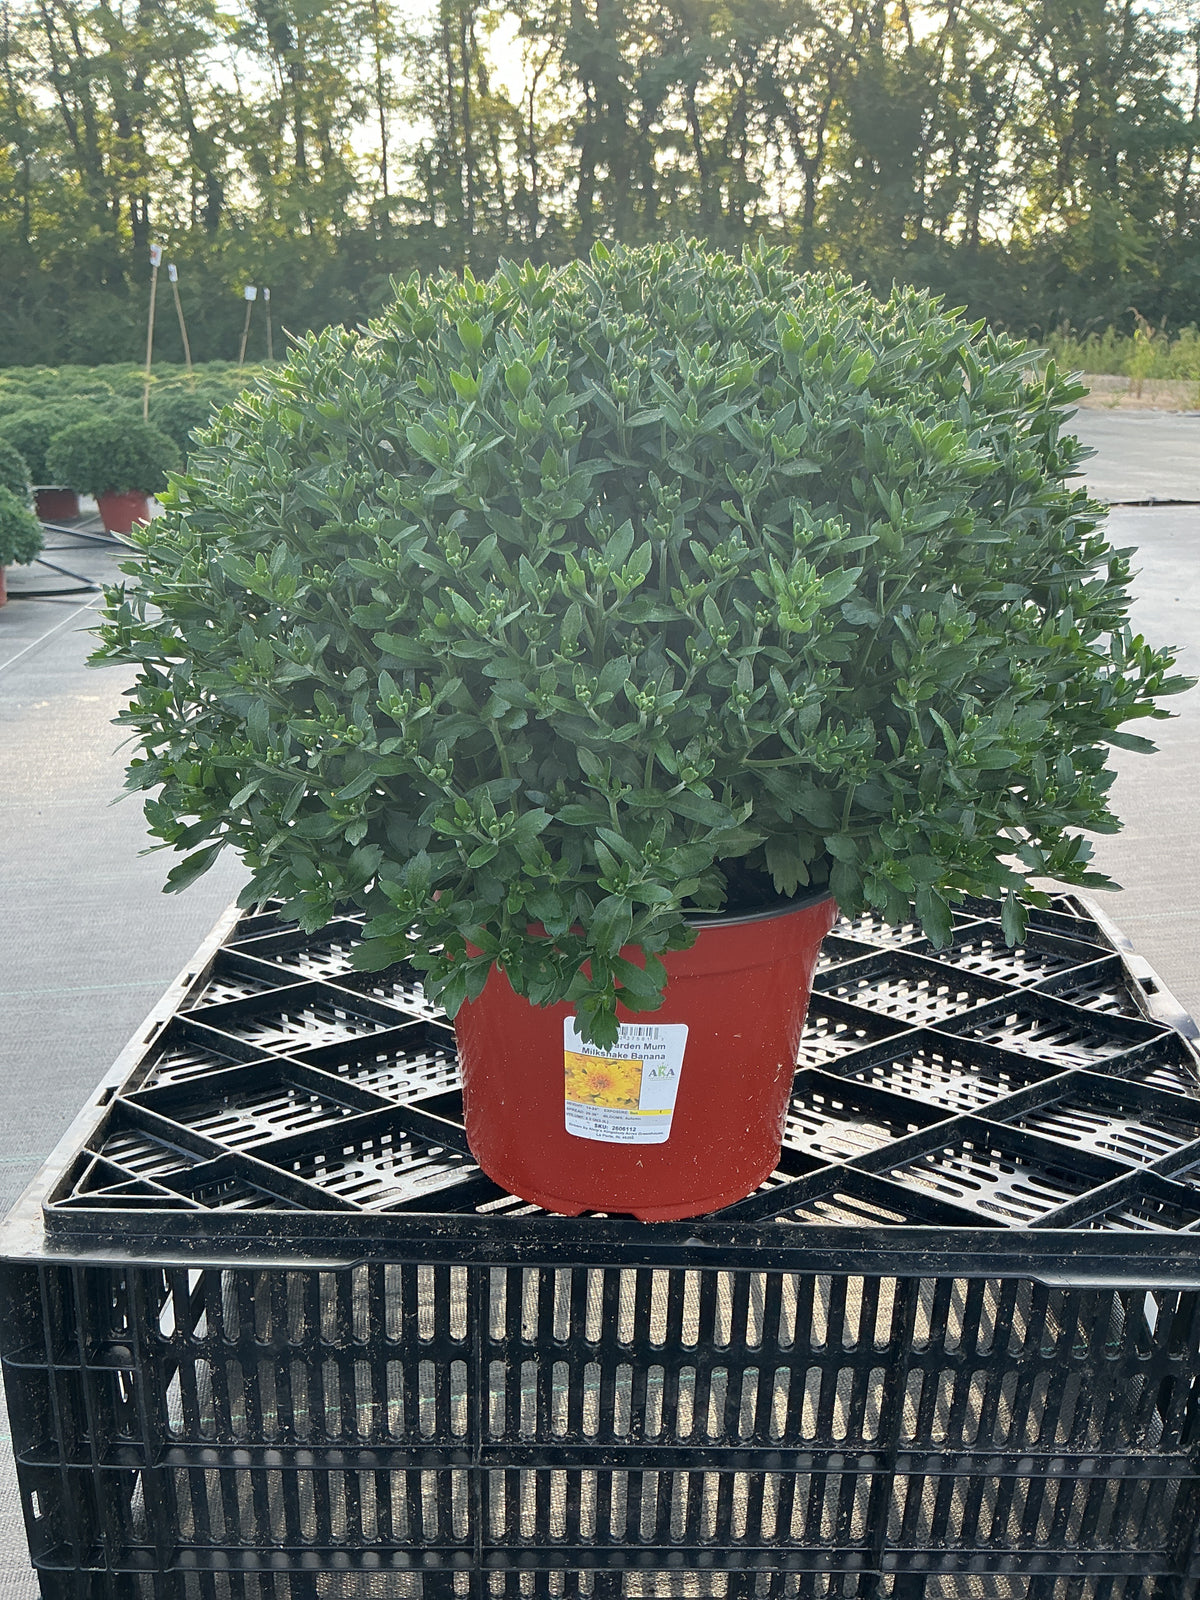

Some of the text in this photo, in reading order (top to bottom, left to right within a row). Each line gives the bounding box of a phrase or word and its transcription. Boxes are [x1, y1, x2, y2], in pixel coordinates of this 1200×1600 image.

[613, 1042, 666, 1050] arden Mum
[581, 1046, 666, 1060] Milkshake Banana
[648, 1065, 675, 1077] AKA
